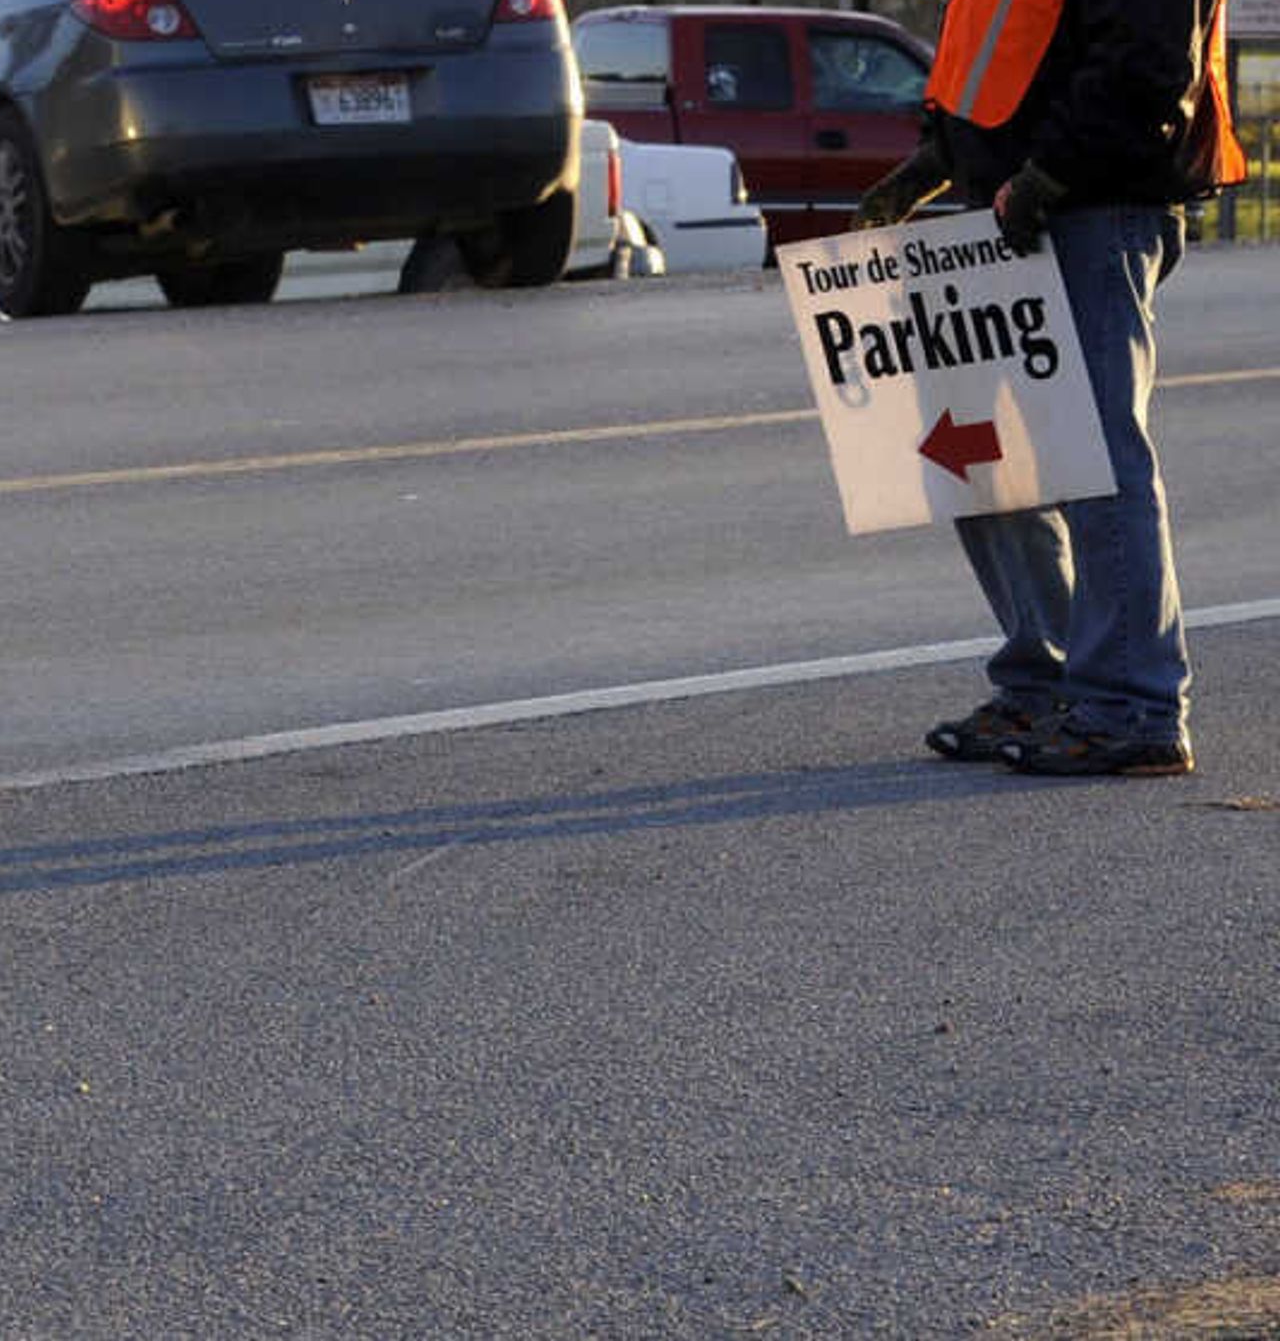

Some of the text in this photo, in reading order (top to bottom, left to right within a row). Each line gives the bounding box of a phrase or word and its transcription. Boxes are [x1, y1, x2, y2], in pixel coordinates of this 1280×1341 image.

[797, 235, 1028, 295] Tour de Shawne
[815, 284, 1059, 385] Parking
